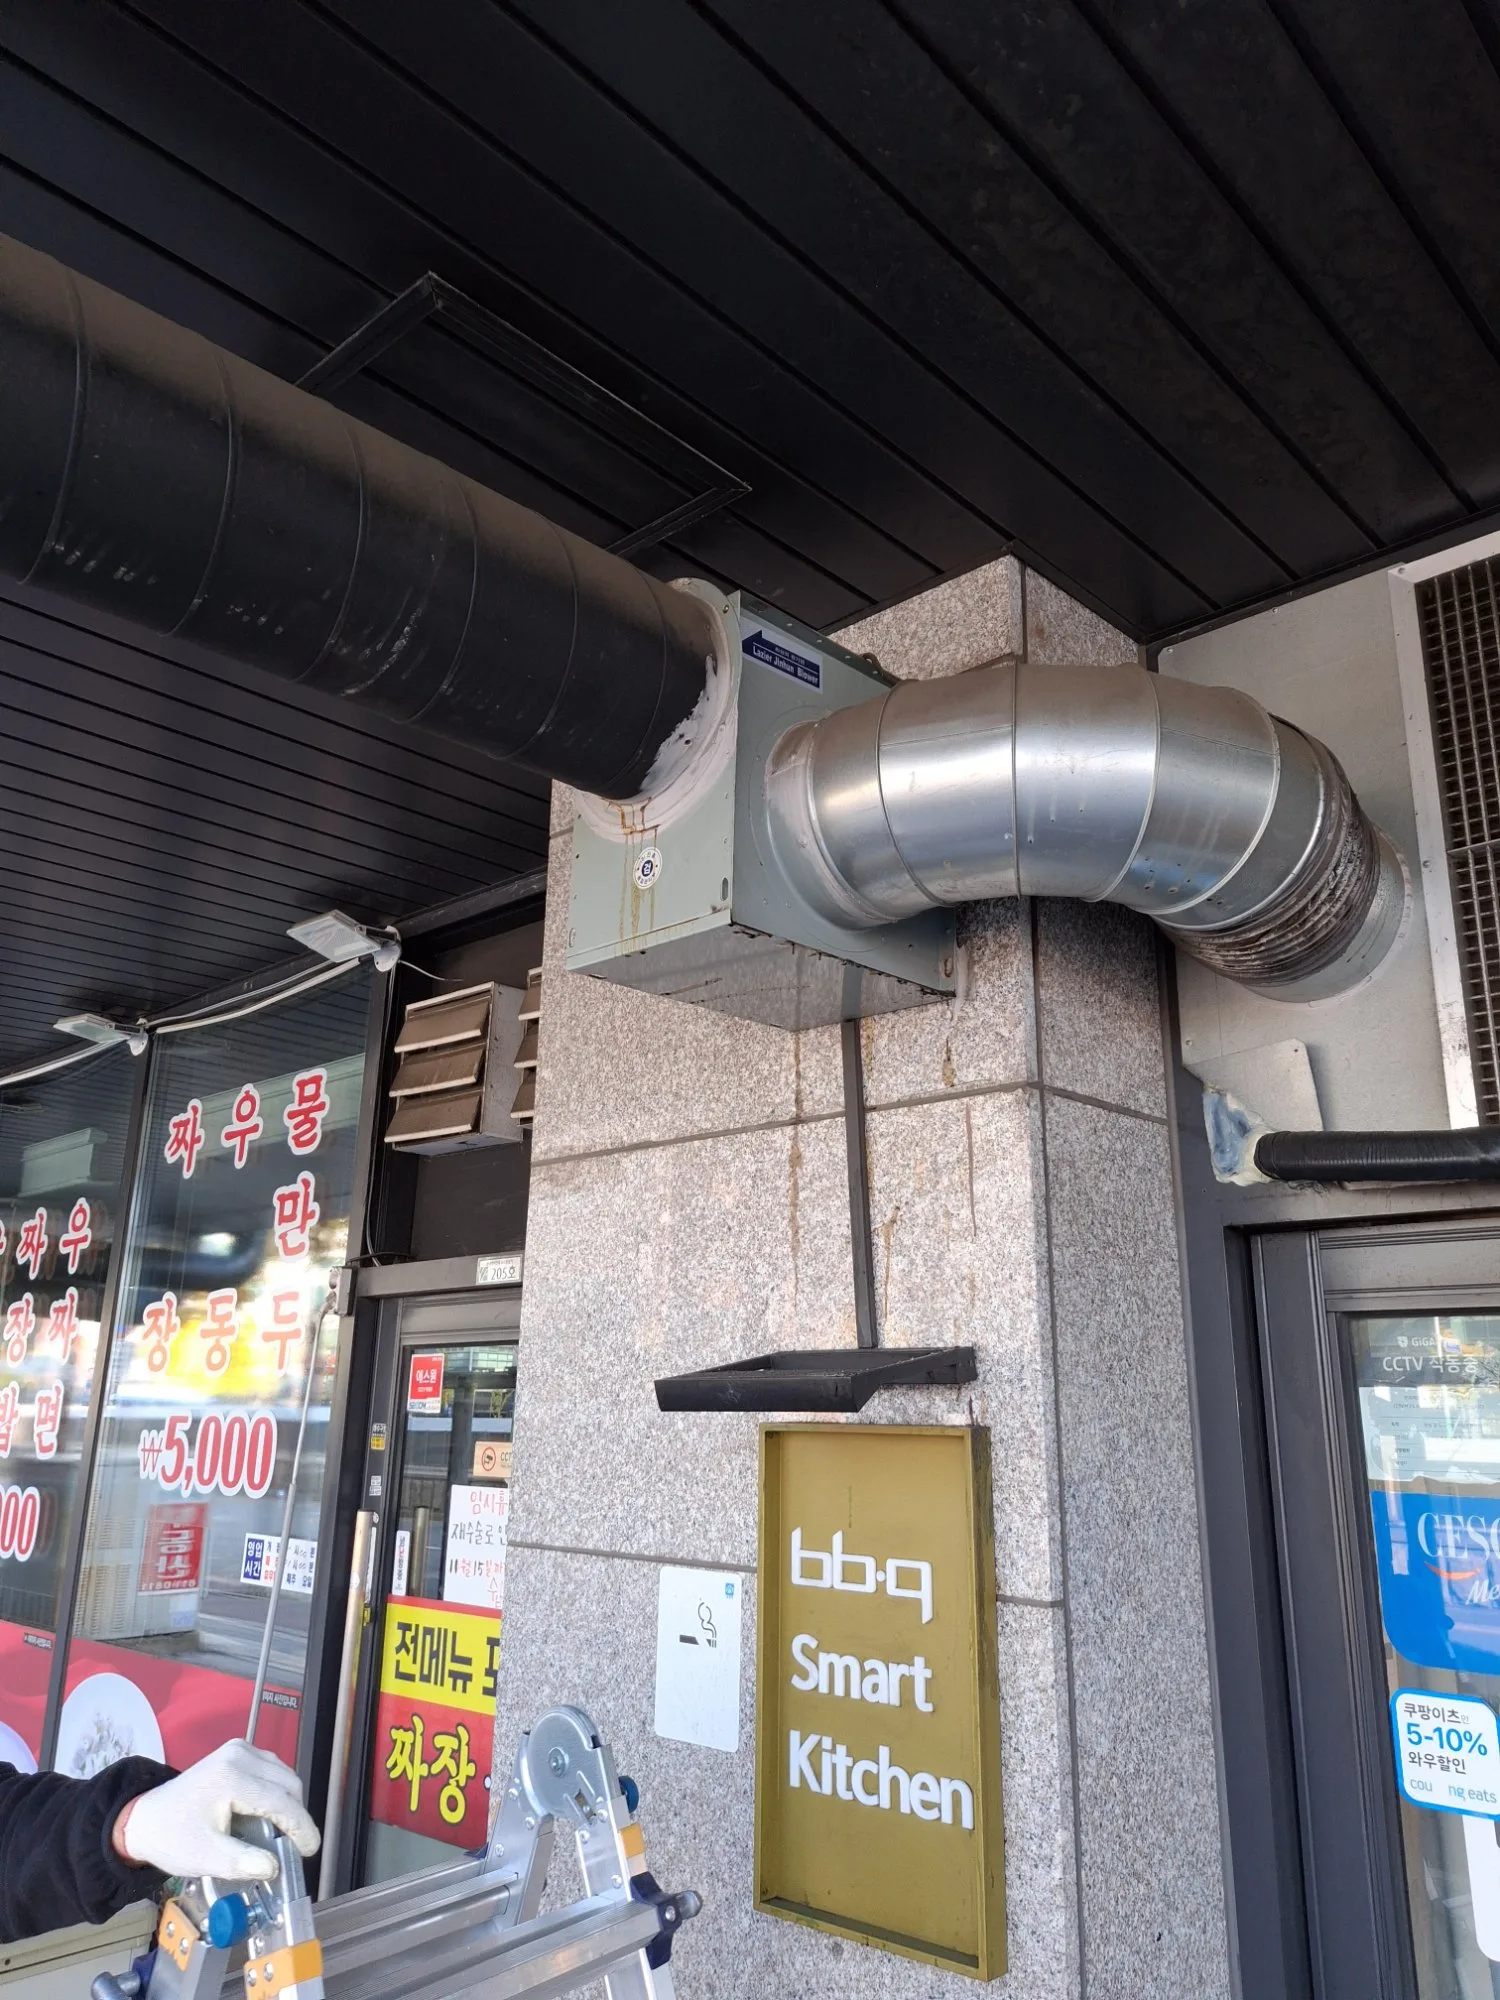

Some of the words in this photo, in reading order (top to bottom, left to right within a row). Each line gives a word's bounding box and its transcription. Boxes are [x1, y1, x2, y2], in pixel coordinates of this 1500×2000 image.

[752, 645, 773, 664] Lazier
[1382, 1356, 1423, 1372] CCTV
[1428, 1356, 1479, 1373] 작동중
[247, 1541, 263, 1558] 영업
[245, 1560, 261, 1577] 시간
[395, 1620, 473, 1694] 전메뉴
[791, 1633, 934, 1712] Smart
[1406, 1722, 1488, 1757] 5-10%
[386, 1715, 477, 1825] 짜장
[1408, 1751, 1467, 1775] 와우할인
[789, 1729, 974, 1830] Kitchen
[1467, 1789, 1498, 1804] eats
